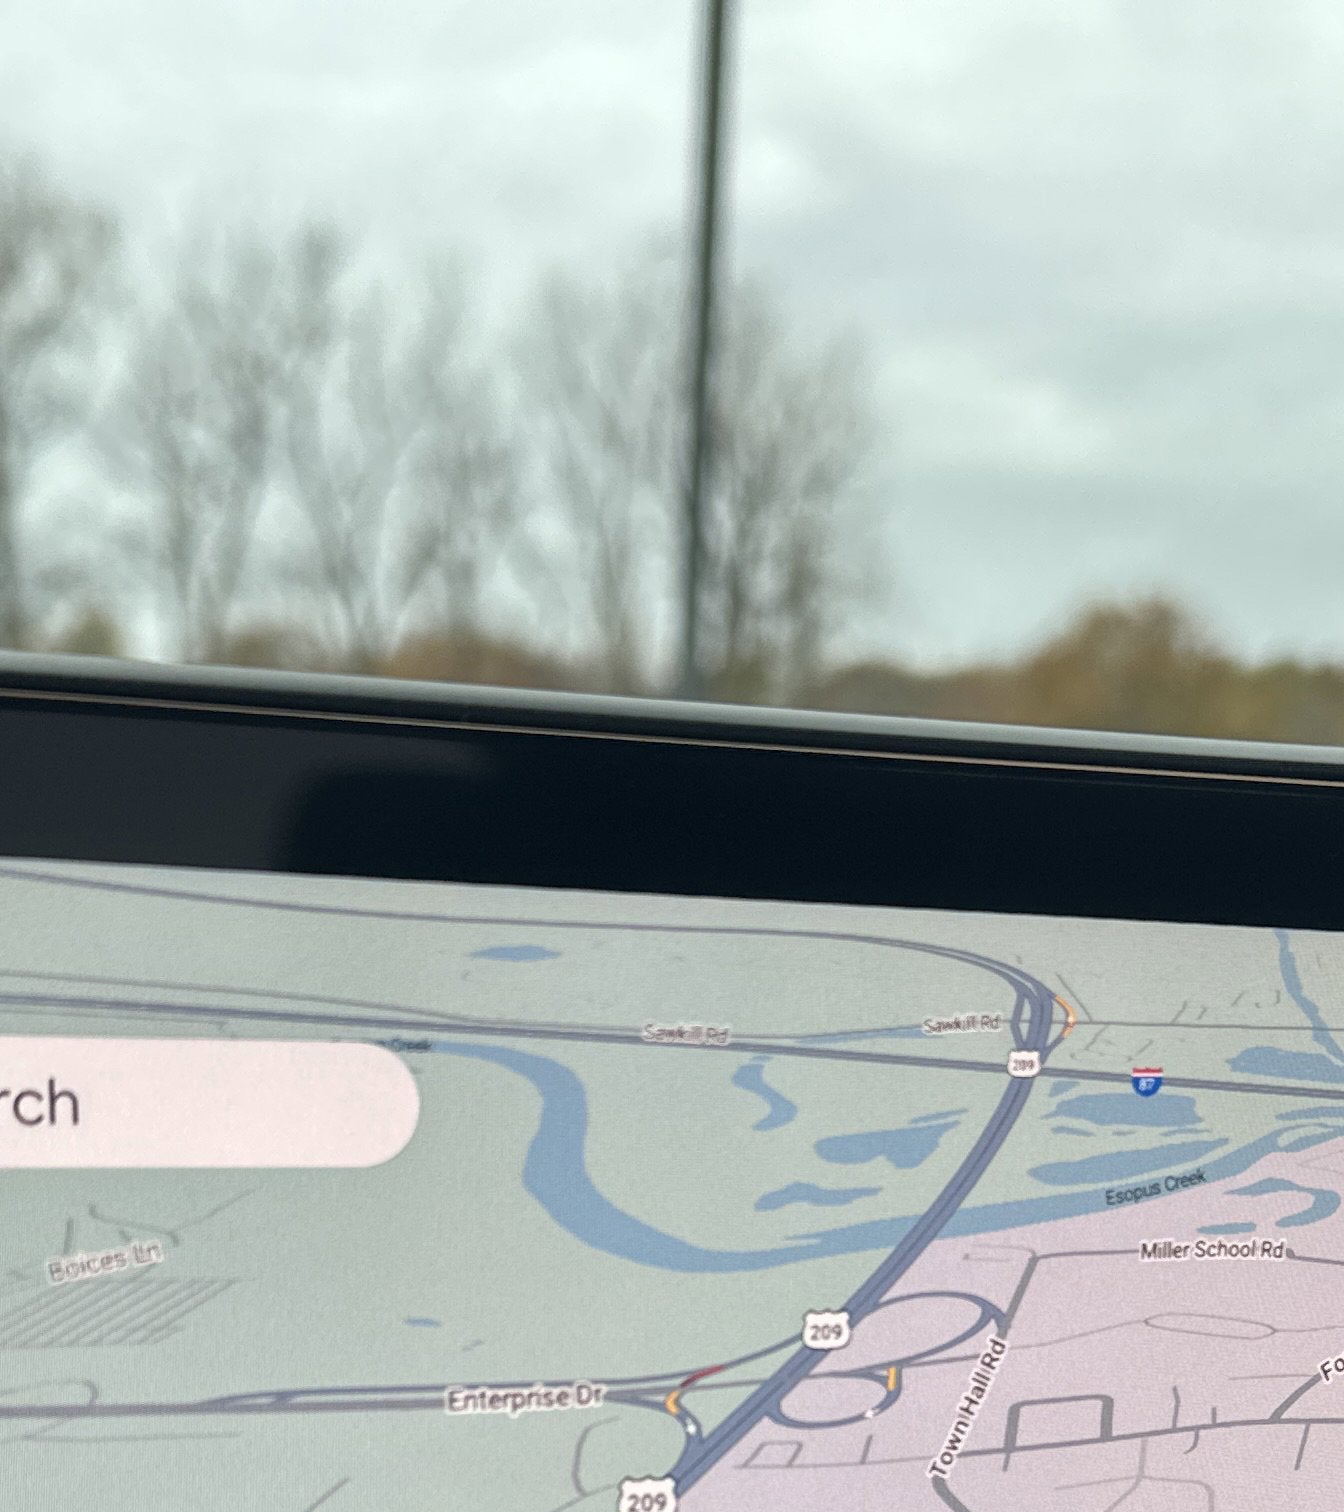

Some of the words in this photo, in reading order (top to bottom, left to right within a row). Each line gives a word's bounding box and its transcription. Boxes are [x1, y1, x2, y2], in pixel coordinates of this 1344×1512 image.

[981, 1014, 1001, 1030] Rd
[1138, 1077, 1156, 1091] 87
[1106, 1181, 1162, 1206] Esopus
[1165, 1168, 1208, 1192] Creek
[1141, 1240, 1190, 1260] Miller
[1194, 1239, 1256, 1259] School
[1260, 1240, 1284, 1259] Rd
[809, 1324, 843, 1340] 209
[447, 1387, 569, 1415] Enterprise
[577, 1385, 605, 1406] Dr
[928, 1419, 970, 1475] Town
[959, 1370, 991, 1416] Hall
[980, 1338, 1007, 1371] Rd
[627, 1492, 667, 1512] 209
